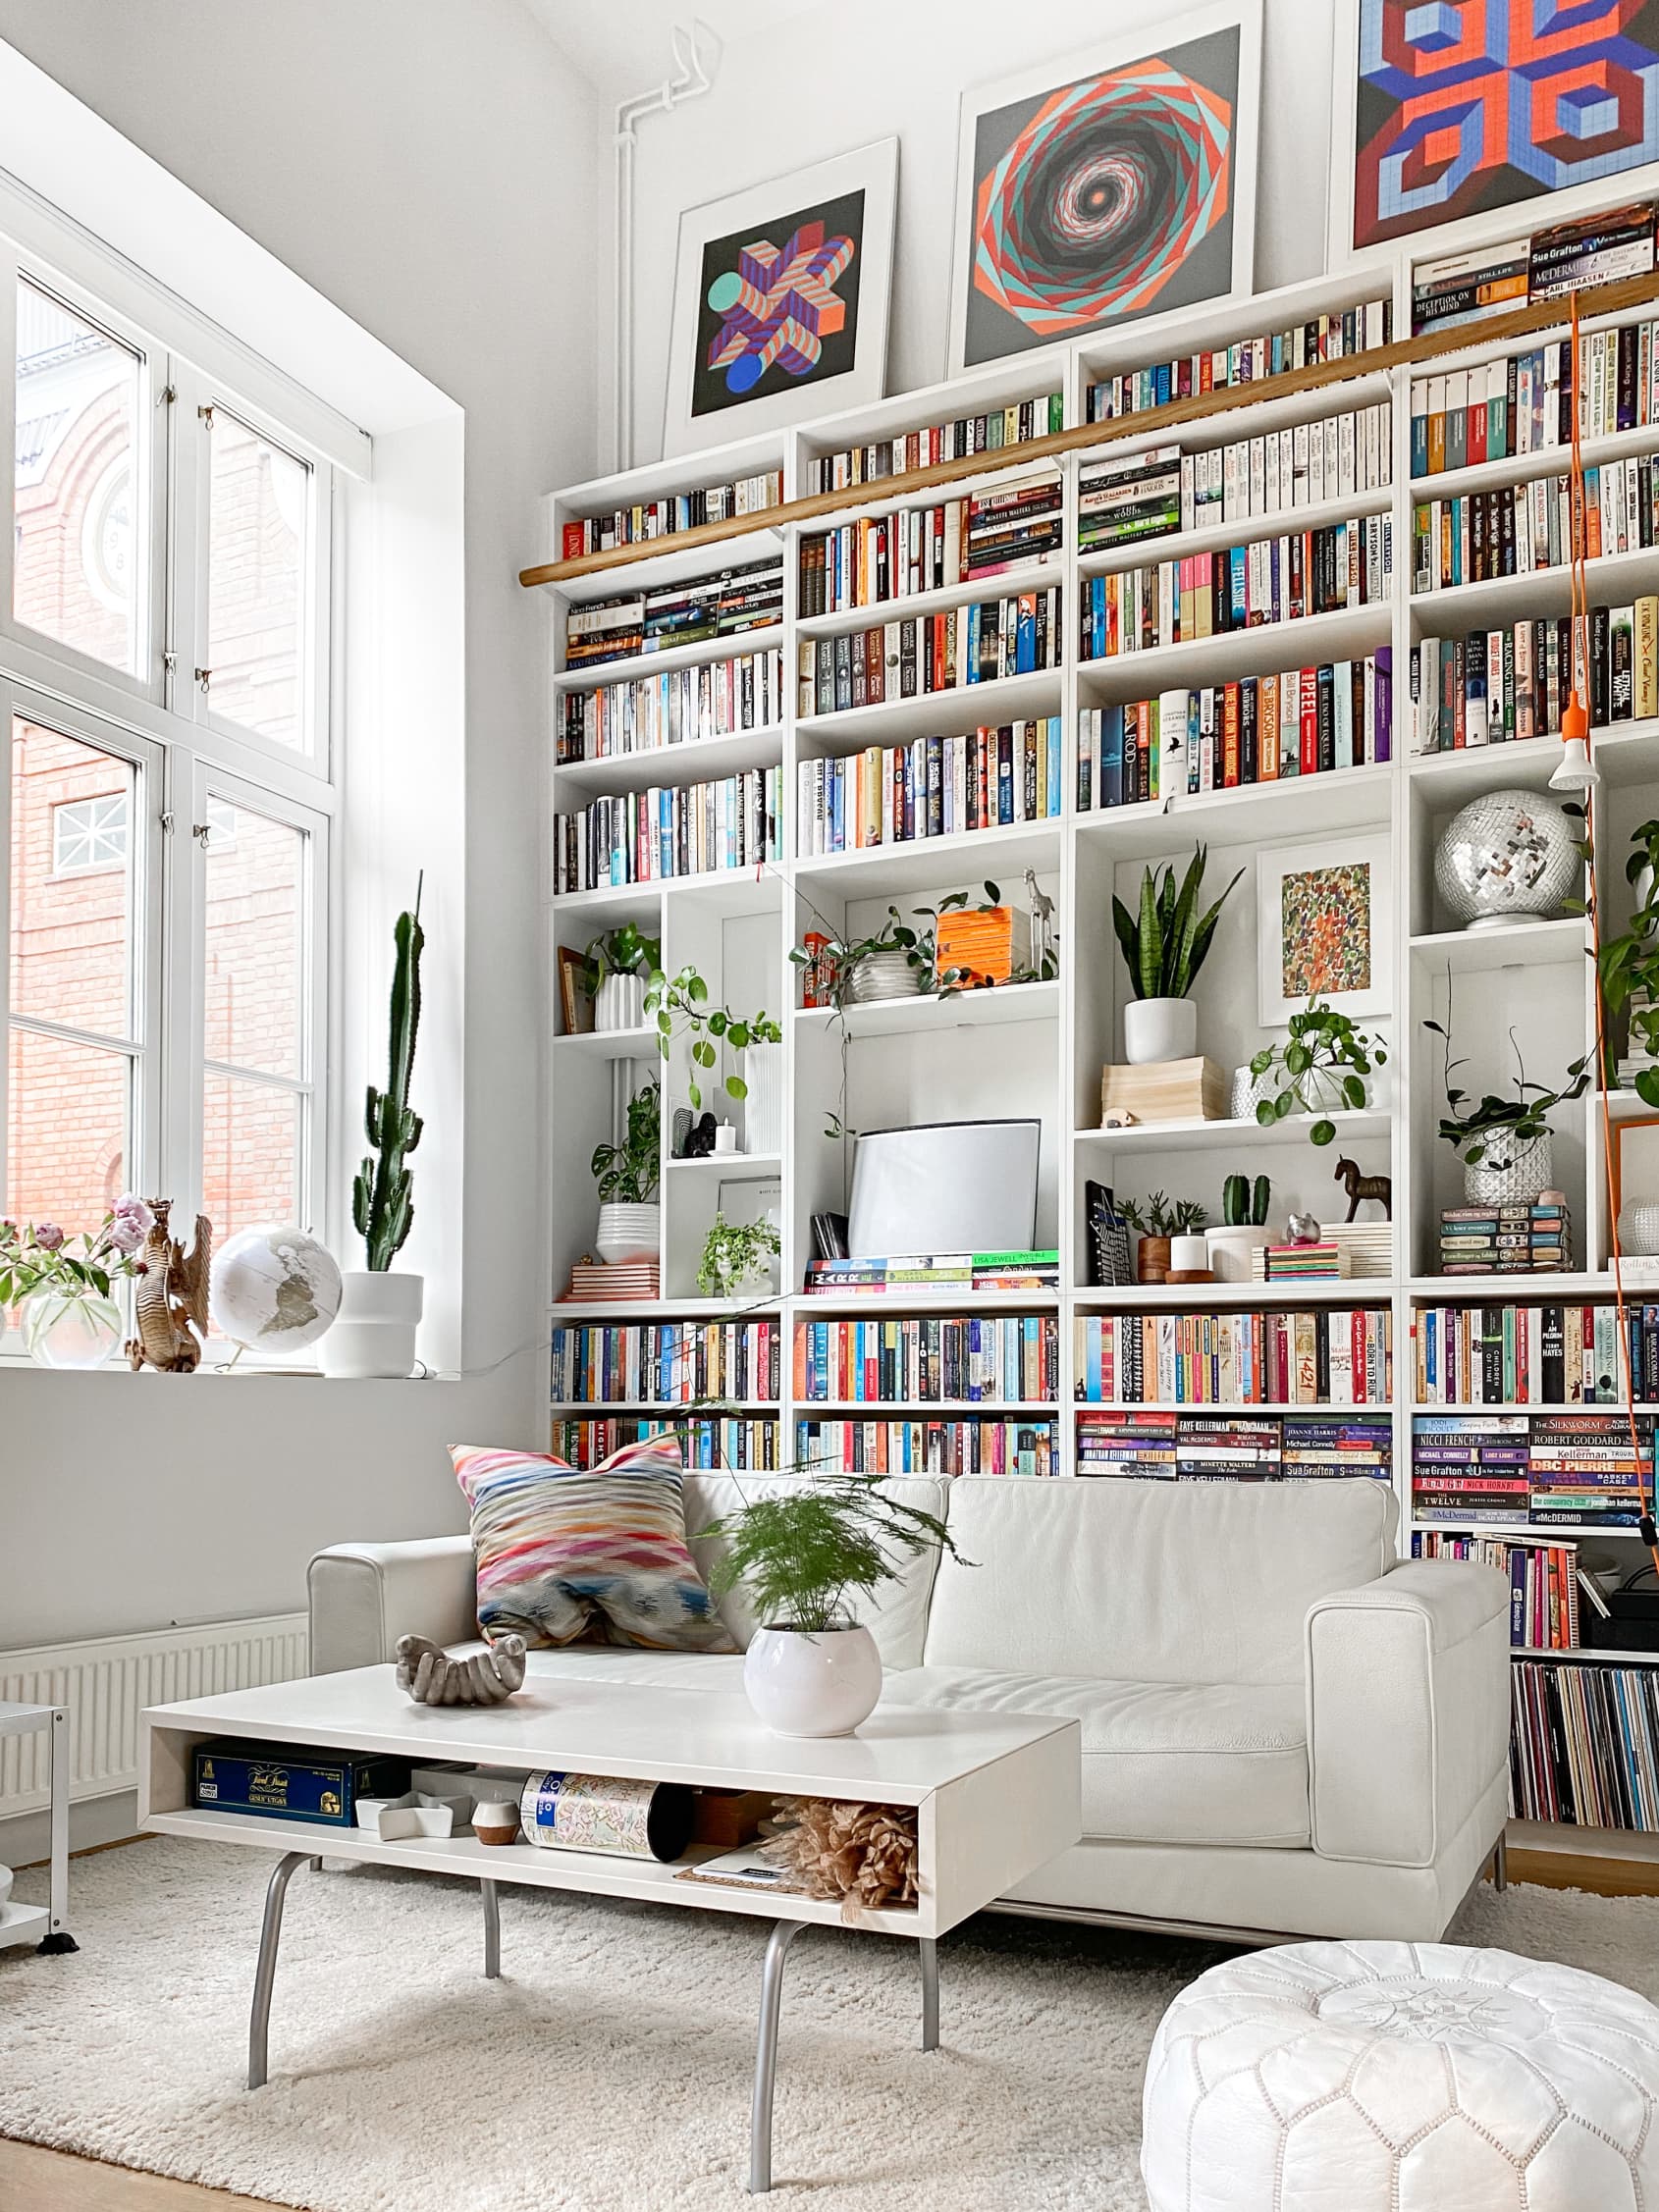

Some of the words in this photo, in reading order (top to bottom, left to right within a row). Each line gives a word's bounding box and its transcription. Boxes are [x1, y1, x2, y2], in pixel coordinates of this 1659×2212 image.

[1532, 253, 1549, 264] Sue
[1550, 243, 1582, 259] Grafton
[1417, 294, 1456, 313] DECEPTION
[1458, 291, 1470, 301] ON
[1439, 301, 1460, 314] MIND
[1508, 363, 1517, 378] ALEX
[1508, 378, 1517, 403] GARLAND
[1232, 565, 1245, 609] FELLSIDE
[585, 602, 605, 612] French
[1504, 642, 1514, 680] RACING
[1286, 673, 1297, 688] Bill
[1622, 670, 1631, 703] LETHAL
[1226, 687, 1237, 704] THE
[1505, 679, 1514, 708] TRIBE
[1613, 674, 1623, 708] WHITE
[1242, 688, 1251, 726] MIRRORS
[1284, 689, 1297, 723] Bryson
[1301, 682, 1316, 717] PEEL
[1226, 705, 1237, 721] BOY
[1263, 696, 1275, 740] BRYSON
[1226, 722, 1237, 734] ON
[1321, 718, 1329, 728] OF
[989, 733, 997, 761] DEXTER'S
[1125, 733, 1137, 764] ROD
[1226, 734, 1237, 750] THE
[1226, 751, 1237, 778] BRIDGE
[974, 1255, 989, 1265] LISA
[990, 1254, 1017, 1264] JEWELL
[1366, 1343, 1376, 1365] BORN
[1486, 1353, 1492, 1362] OF
[1298, 1355, 1313, 1390] 1421
[1366, 1365, 1376, 1377] TO
[1366, 1379, 1376, 1396] RUN
[1179, 1421, 1195, 1432] FAYE
[1549, 1419, 1601, 1430] SILKWORM
[1420, 1436, 1442, 1447] NICCI
[1445, 1435, 1474, 1447] FRENCH
[1534, 1436, 1572, 1446] ROBERT
[1573, 1436, 1622, 1446] GODDARD
[1557, 1450, 1608, 1459] Kellerman
[1287, 1464, 1303, 1476] Sue
[1304, 1464, 1335, 1477] Grafton
[1339, 1466, 1345, 1476] S
[1415, 1465, 1430, 1476] Sue
[1430, 1465, 1463, 1476] Grafton
[1472, 1465, 1482, 1477] U
[1531, 1460, 1562, 1472] DBC
[1565, 1460, 1616, 1472] PIERRE
[1540, 1514, 1581, 1523] McDERMID
